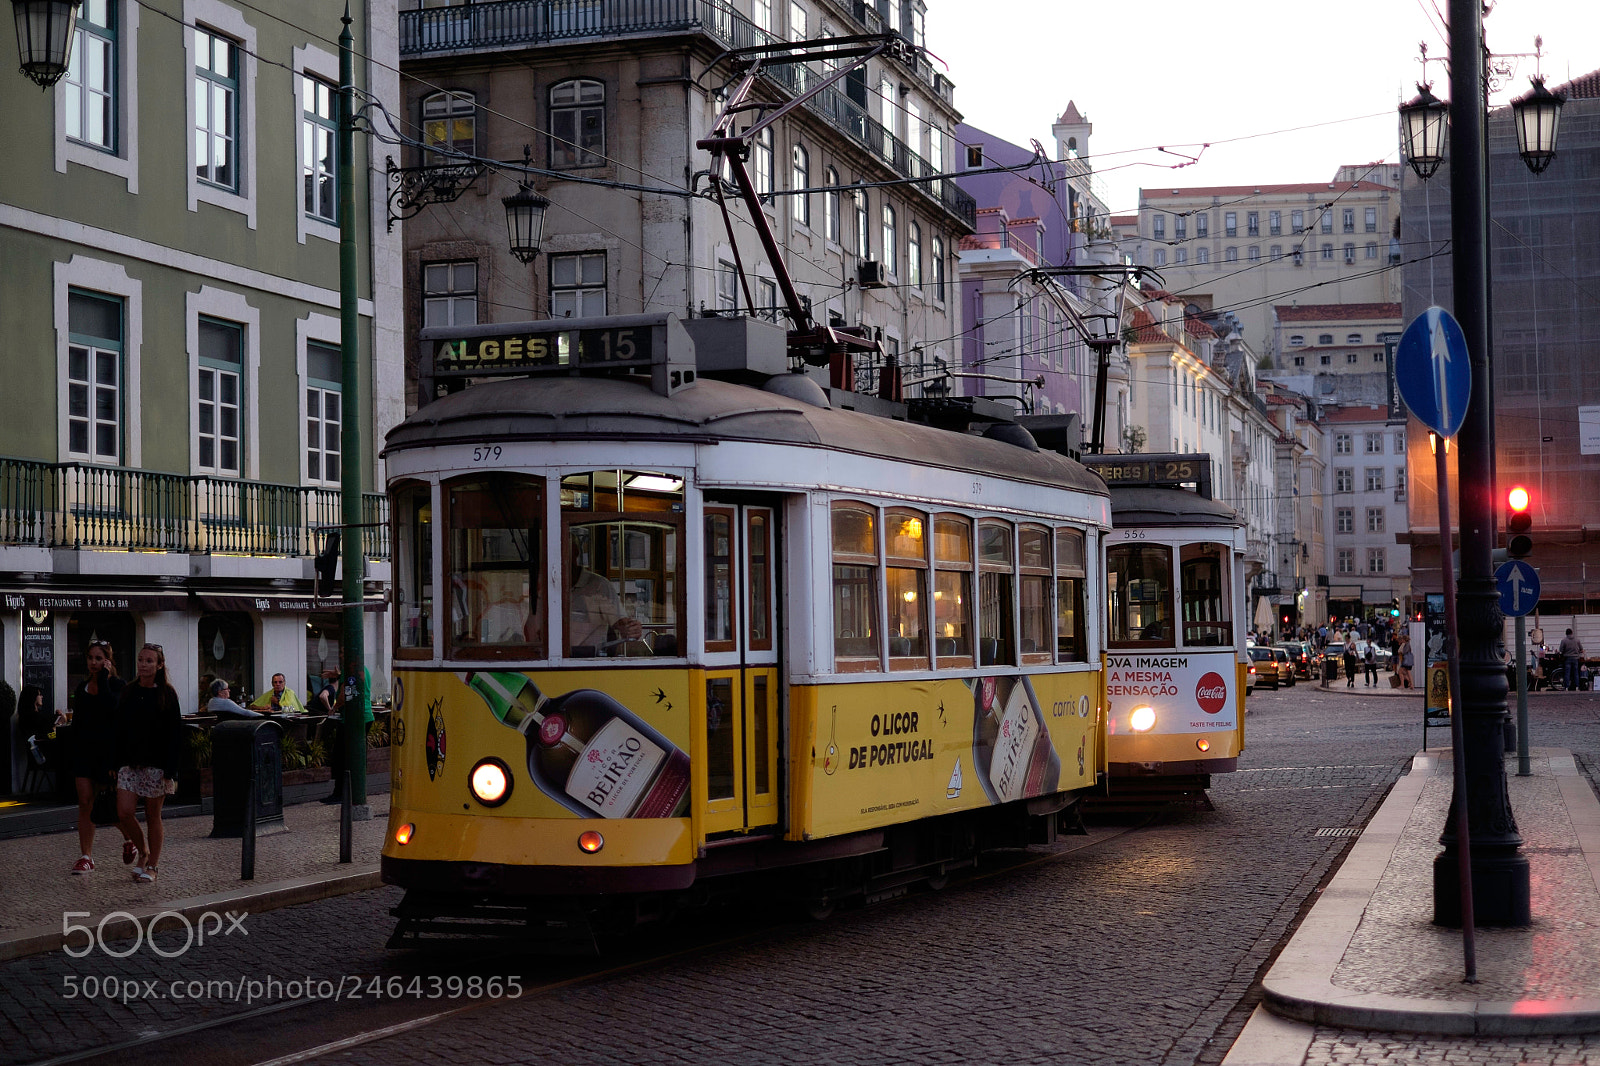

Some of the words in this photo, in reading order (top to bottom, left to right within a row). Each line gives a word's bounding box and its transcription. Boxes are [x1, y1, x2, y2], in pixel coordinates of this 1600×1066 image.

[600, 330, 637, 360] 15
[473, 446, 502, 463] 579
[1165, 462, 1193, 480] 25
[972, 481, 983, 495] 579
[1124, 529, 1146, 540] 556
[39, 598, 82, 607] RESTAURANTE
[87, 599, 92, 608] &
[97, 599, 115, 608] TAPAS
[117, 599, 129, 608] BAR
[279, 601, 309, 610] RESTAURANTE
[1136, 658, 1188, 668] IMAGEM
[1111, 671, 1120, 682] A
[1125, 671, 1173, 682] MESMA
[1107, 683, 1178, 698] SENSAÇÃO
[1053, 695, 1075, 717] carris
[870, 714, 881, 737] O
[882, 710, 920, 737] LICOR
[849, 746, 868, 770] DE
[869, 738, 934, 768] PORTUGAL
[587, 737, 641, 807] BEIRÃO
[594, 748, 617, 781] LICOR
